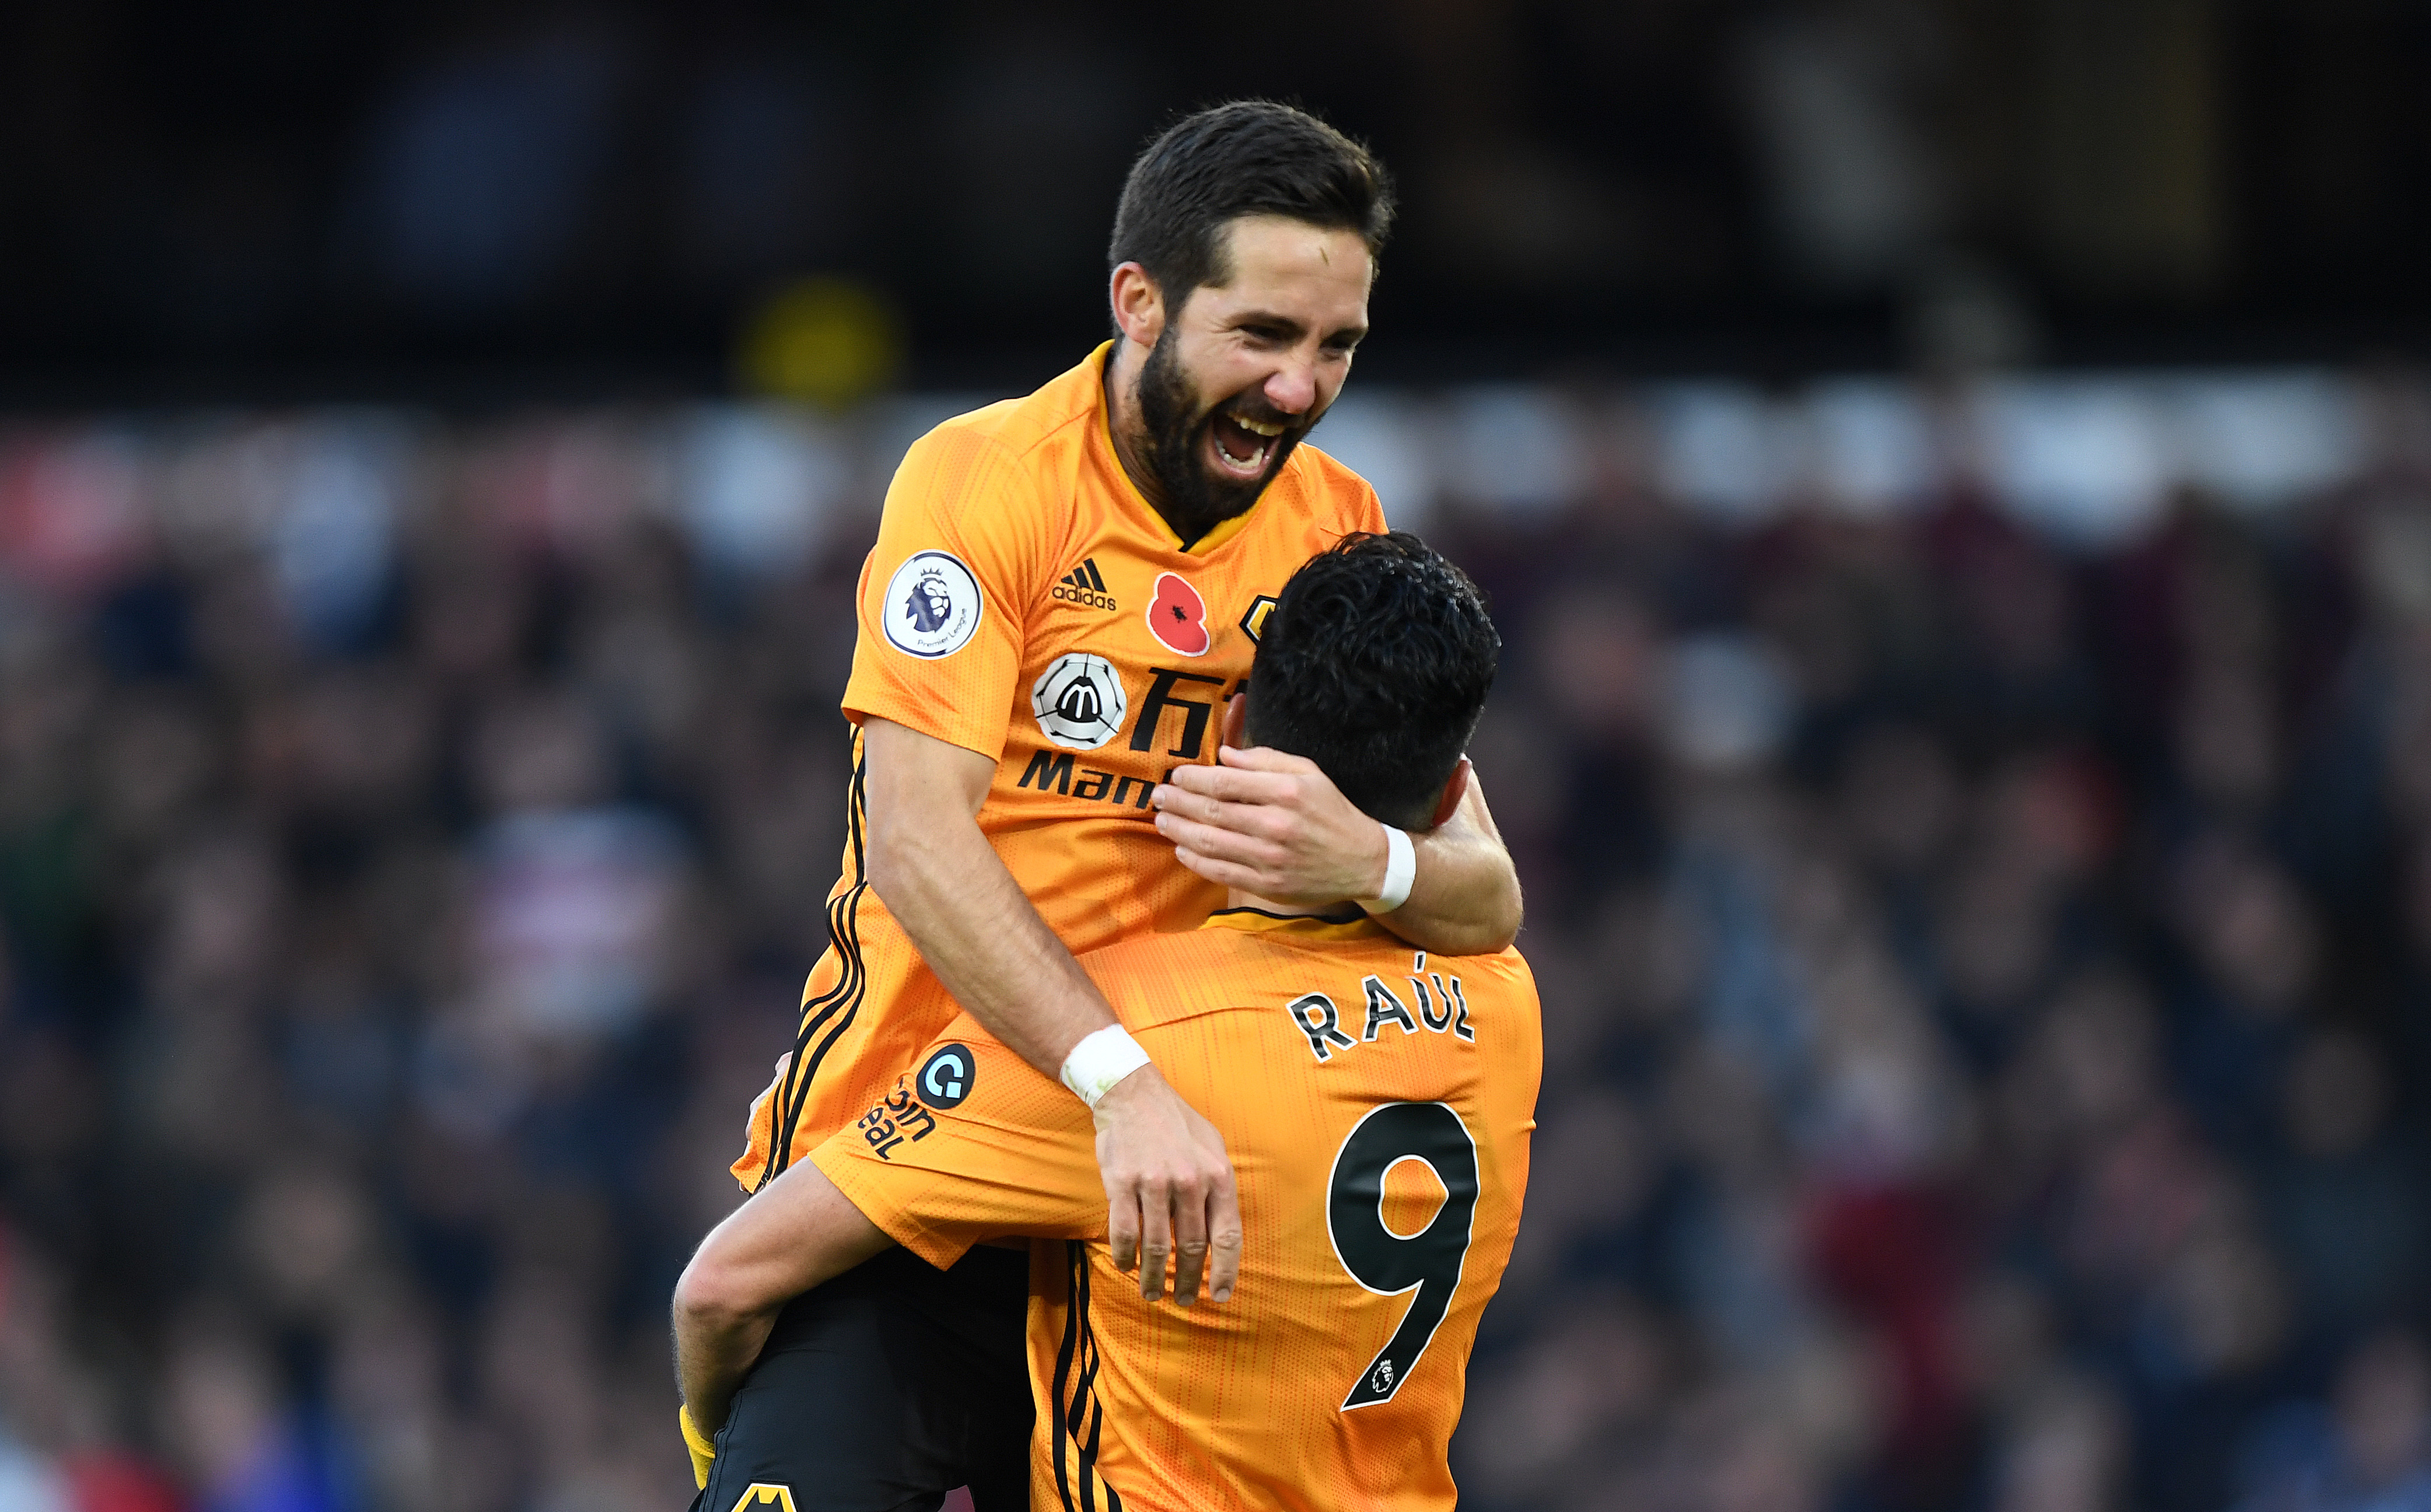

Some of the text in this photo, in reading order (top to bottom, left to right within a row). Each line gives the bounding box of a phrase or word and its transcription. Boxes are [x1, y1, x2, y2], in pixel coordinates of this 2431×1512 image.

[918, 608, 967, 648] Premier League
[1052, 586, 1117, 611] adidas
[1017, 749, 1173, 811] Man
[1285, 951, 1475, 1063] RAÚL
[858, 1104, 905, 1160] eal
[884, 1077, 936, 1143] oin
[1325, 1101, 1481, 1413] 9
